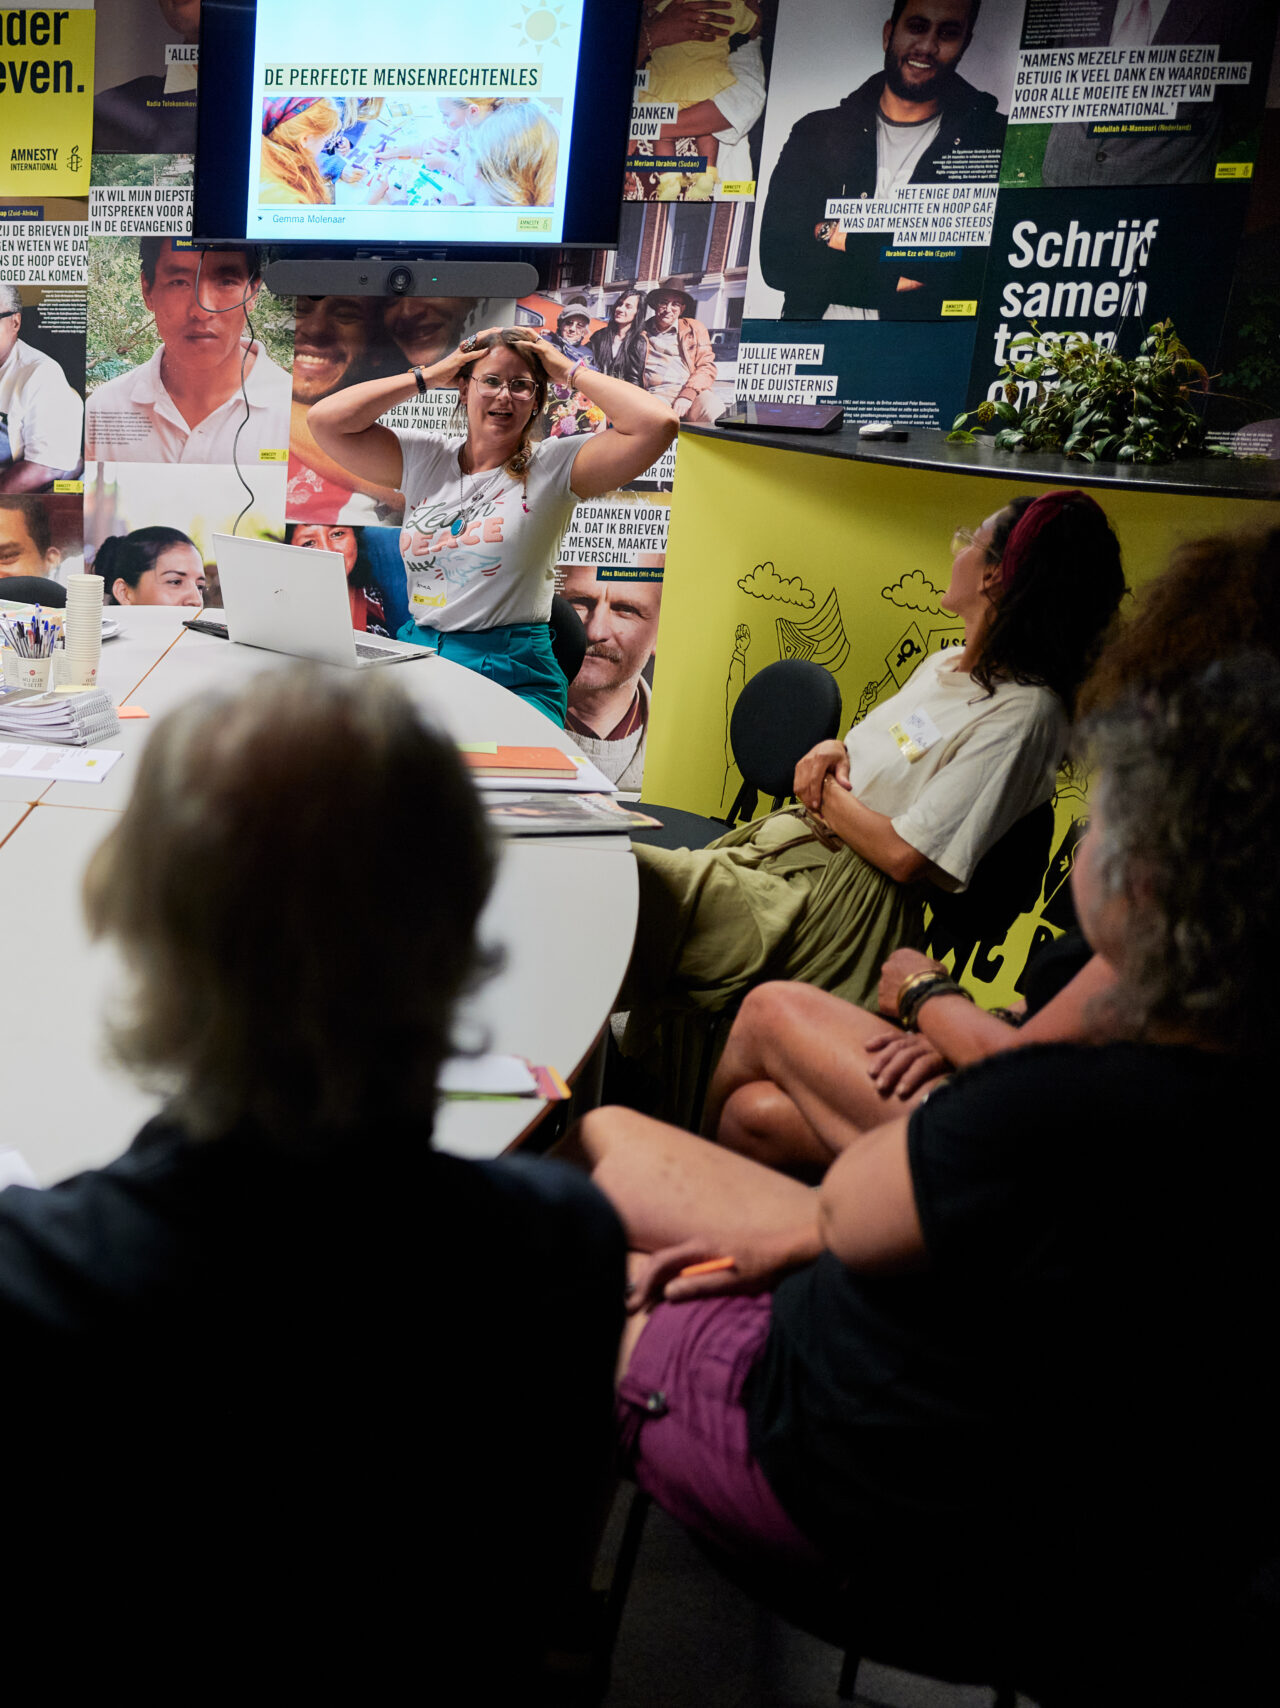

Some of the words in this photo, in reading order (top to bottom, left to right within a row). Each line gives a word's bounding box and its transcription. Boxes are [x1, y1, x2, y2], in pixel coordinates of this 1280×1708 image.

[1020, 52, 1074, 67] 'NAMENS
[1078, 50, 1126, 65] MEZELF
[1129, 50, 1144, 63] EN
[1148, 50, 1177, 63] MIJN
[1179, 49, 1215, 63] GEZIN
[264, 68, 284, 86] DE
[290, 68, 367, 86] PERFECTE
[374, 68, 538, 86] MENSENRECHTENLES
[1017, 71, 1062, 85] BETUIG
[1065, 70, 1078, 83] IK
[1082, 69, 1110, 82] VEEL
[1114, 68, 1146, 82] DANK
[1149, 68, 1165, 81] EN
[1168, 66, 1247, 80] WAARDERING
[1014, 88, 1047, 102] VOOR
[1050, 87, 1080, 101] ALLE
[1083, 86, 1128, 100] MOEITE
[1132, 86, 1147, 99] EN
[1151, 85, 1186, 98] INZET
[1188, 84, 1211, 97] VAN
[1011, 105, 1068, 120] AMNESTY
[1072, 102, 1174, 118] INTERNATIONAL.'
[11, 148, 58, 161] AMNESTY
[11, 163, 58, 171] INTERNATIONAL
[91, 190, 104, 202] 'IK
[108, 190, 126, 202] WIL
[129, 190, 151, 202] MIJN
[895, 188, 917, 199] 'HET
[920, 188, 950, 199] ENIGE
[952, 188, 970, 198] DAT
[973, 188, 997, 198] MIJN
[92, 206, 153, 217] UITSPREKEN
[158, 206, 183, 217] VOOR
[829, 203, 863, 214] DAGEN
[865, 203, 924, 214] VERLICHTTE
[927, 203, 940, 213] EN
[943, 202, 970, 213] HOOP
[972, 202, 994, 214] GAF,
[272, 214, 304, 224] Gemma
[308, 214, 346, 224] Molenaar
[843, 218, 865, 228] WAS
[867, 218, 884, 228] DAT
[888, 217, 929, 228] MENSEN
[932, 217, 952, 228] NOG
[955, 216, 992, 228] STEEDS
[13, 225, 25, 236] DE
[28, 225, 70, 236] BRIEVEN
[74, 225, 88, 236] DIE
[91, 221, 102, 232] IN
[105, 221, 117, 232] DE
[120, 221, 183, 232] GEVANGENIS
[896, 232, 917, 242] AAN
[920, 231, 936, 242] MIJ
[938, 231, 991, 242] DACHTEN.'
[16, 240, 51, 251] WETEN
[54, 240, 69, 251] WE
[72, 240, 88, 251] DAT
[1008, 219, 1159, 277] Schrijf
[12, 255, 25, 266] DE
[28, 255, 55, 266] HOOP
[57, 255, 88, 266] GEVEN
[0, 270, 26, 281] GOED
[29, 270, 46, 281] ZAL
[1000, 281, 1147, 317] samen
[741, 347, 777, 360] 'JULLIE
[781, 348, 820, 361] WAREN
[738, 363, 758, 375] HET
[761, 363, 792, 375] LICHT
[737, 378, 748, 390] IN
[751, 378, 765, 391] DE
[768, 379, 834, 392] DUISTERNIS
[576, 508, 631, 519] BEDANKEN
[634, 509, 662, 520] VOOR
[585, 522, 604, 534] DAT
[606, 523, 616, 534] IK
[619, 524, 664, 535] BRIEVEN
[399, 517, 504, 557] PEACE
[569, 537, 614, 550] MENSEN,
[618, 538, 658, 550] MAAKTE
[578, 551, 635, 563] VERSCHIL.'
